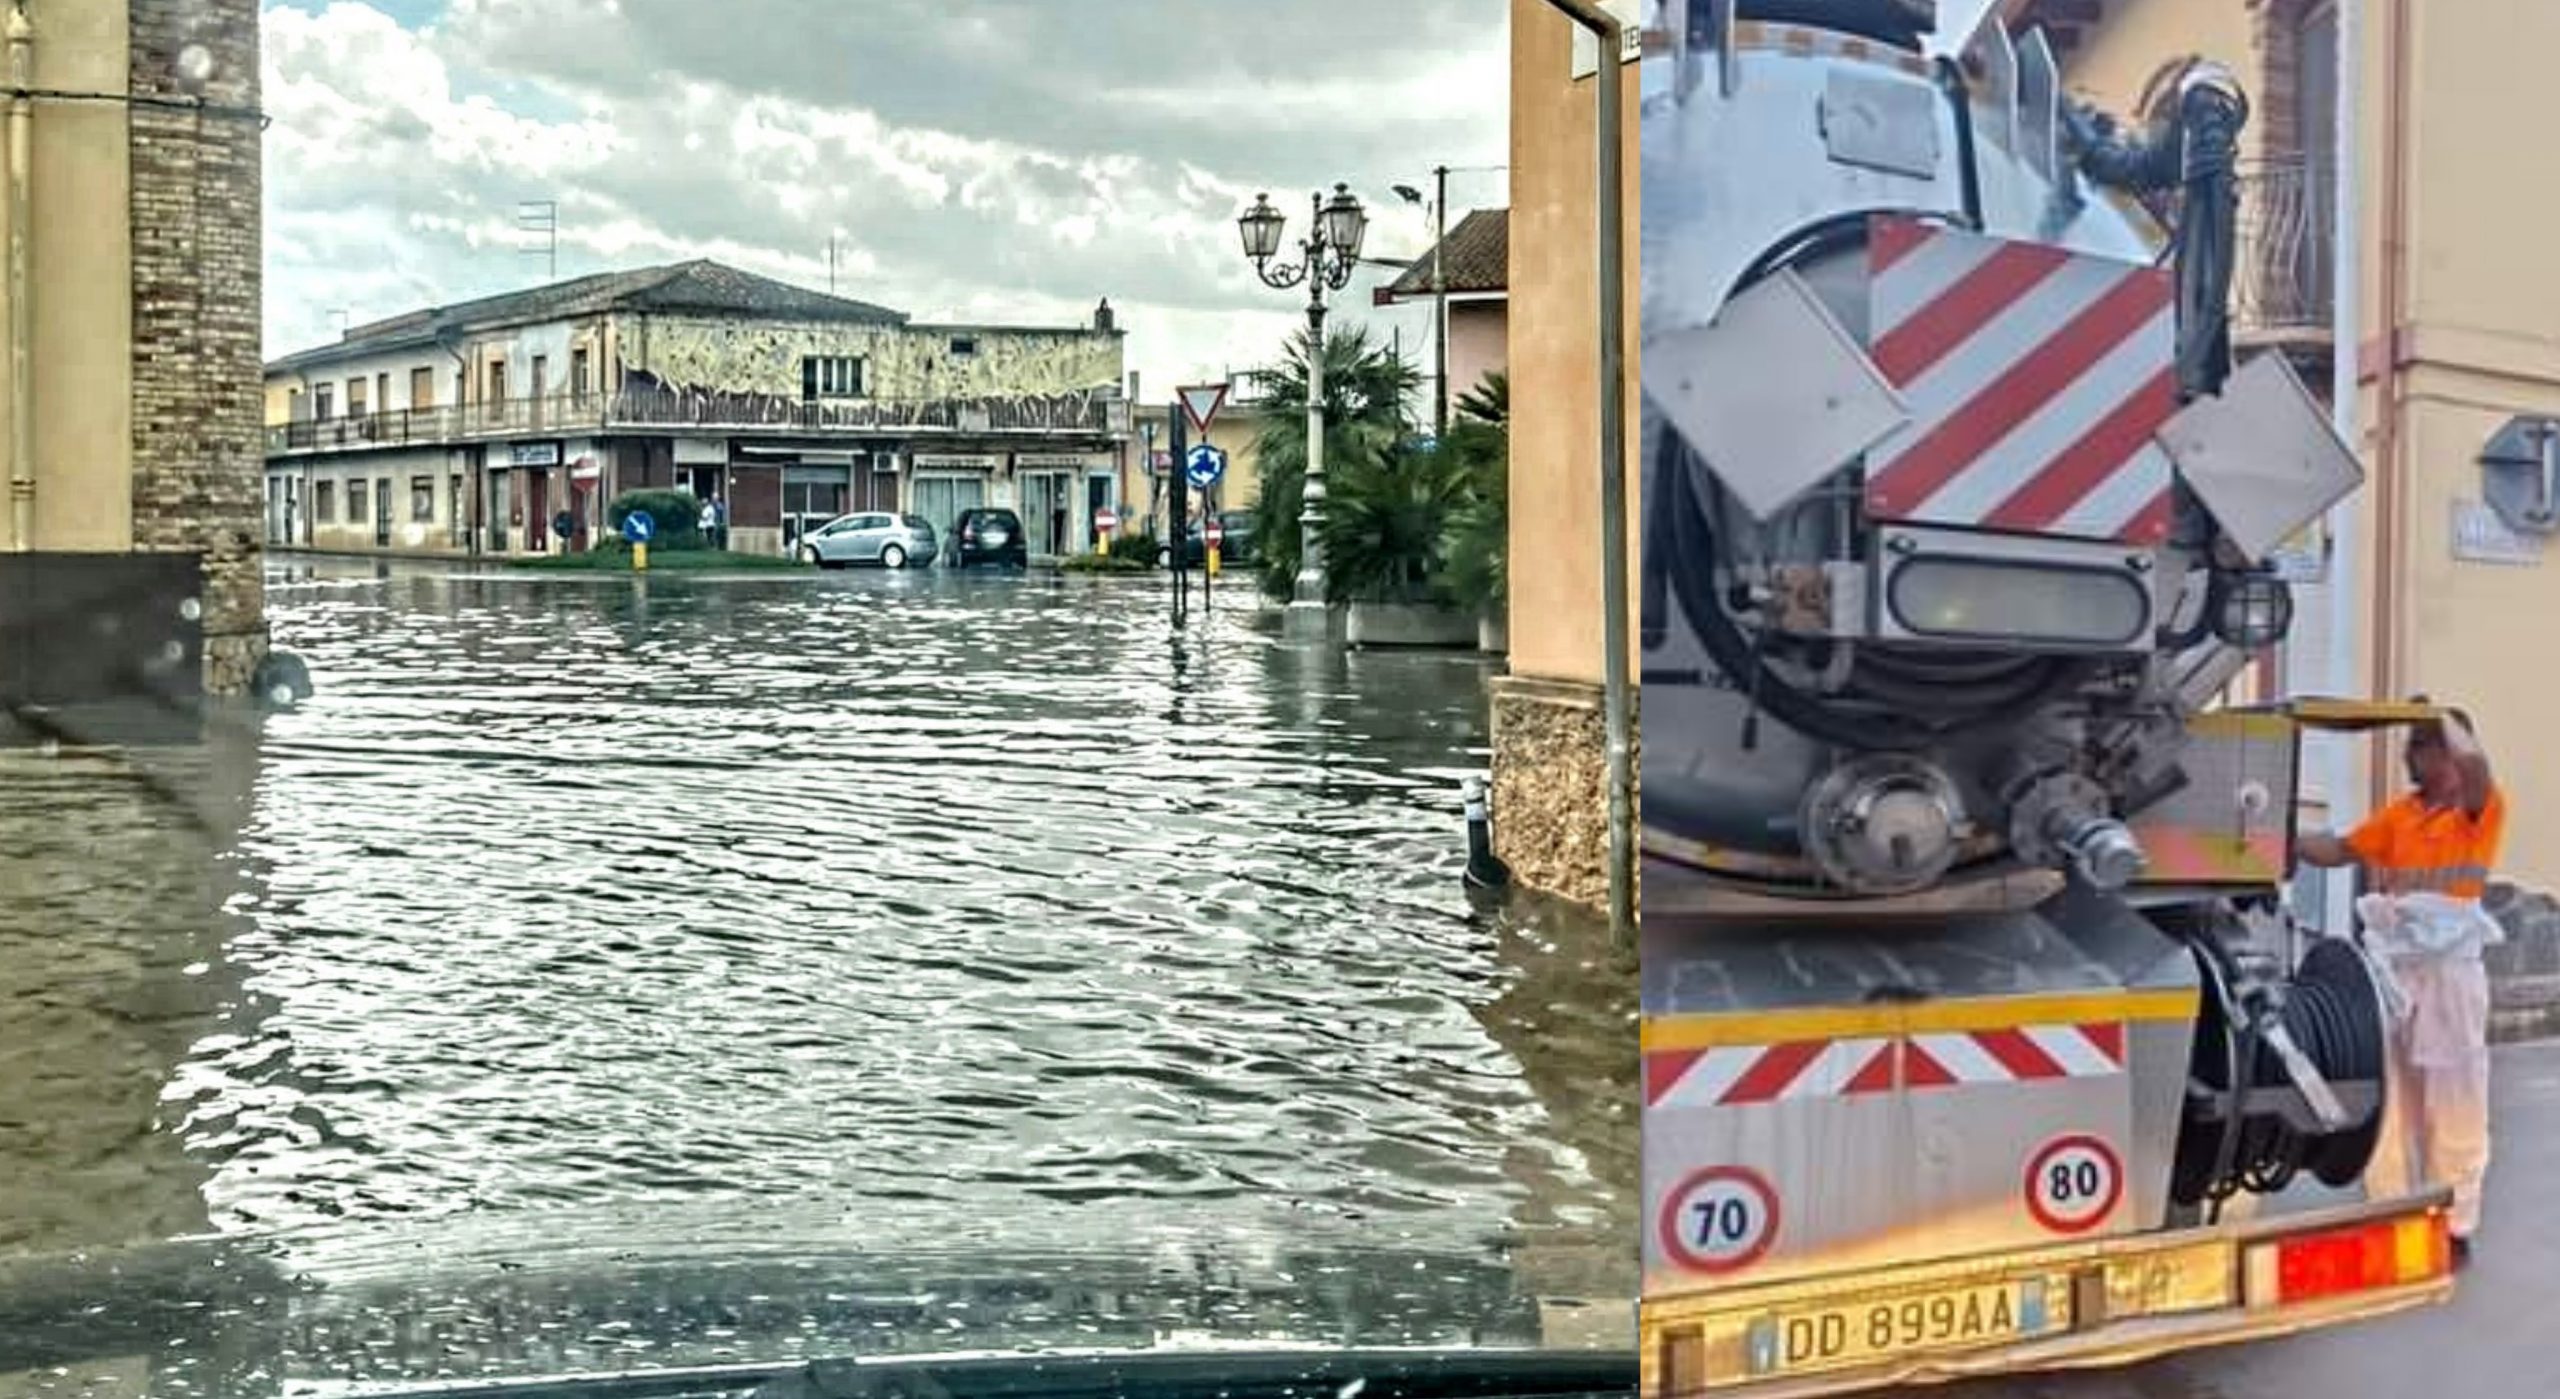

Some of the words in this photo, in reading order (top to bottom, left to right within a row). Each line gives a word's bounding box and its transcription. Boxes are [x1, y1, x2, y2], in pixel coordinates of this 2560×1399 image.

[2050, 1161, 2098, 1201] 80
[1693, 1199, 1747, 1245] 70
[1786, 1313, 1846, 1361] DD
[1867, 1288, 2012, 1348] 899AA
